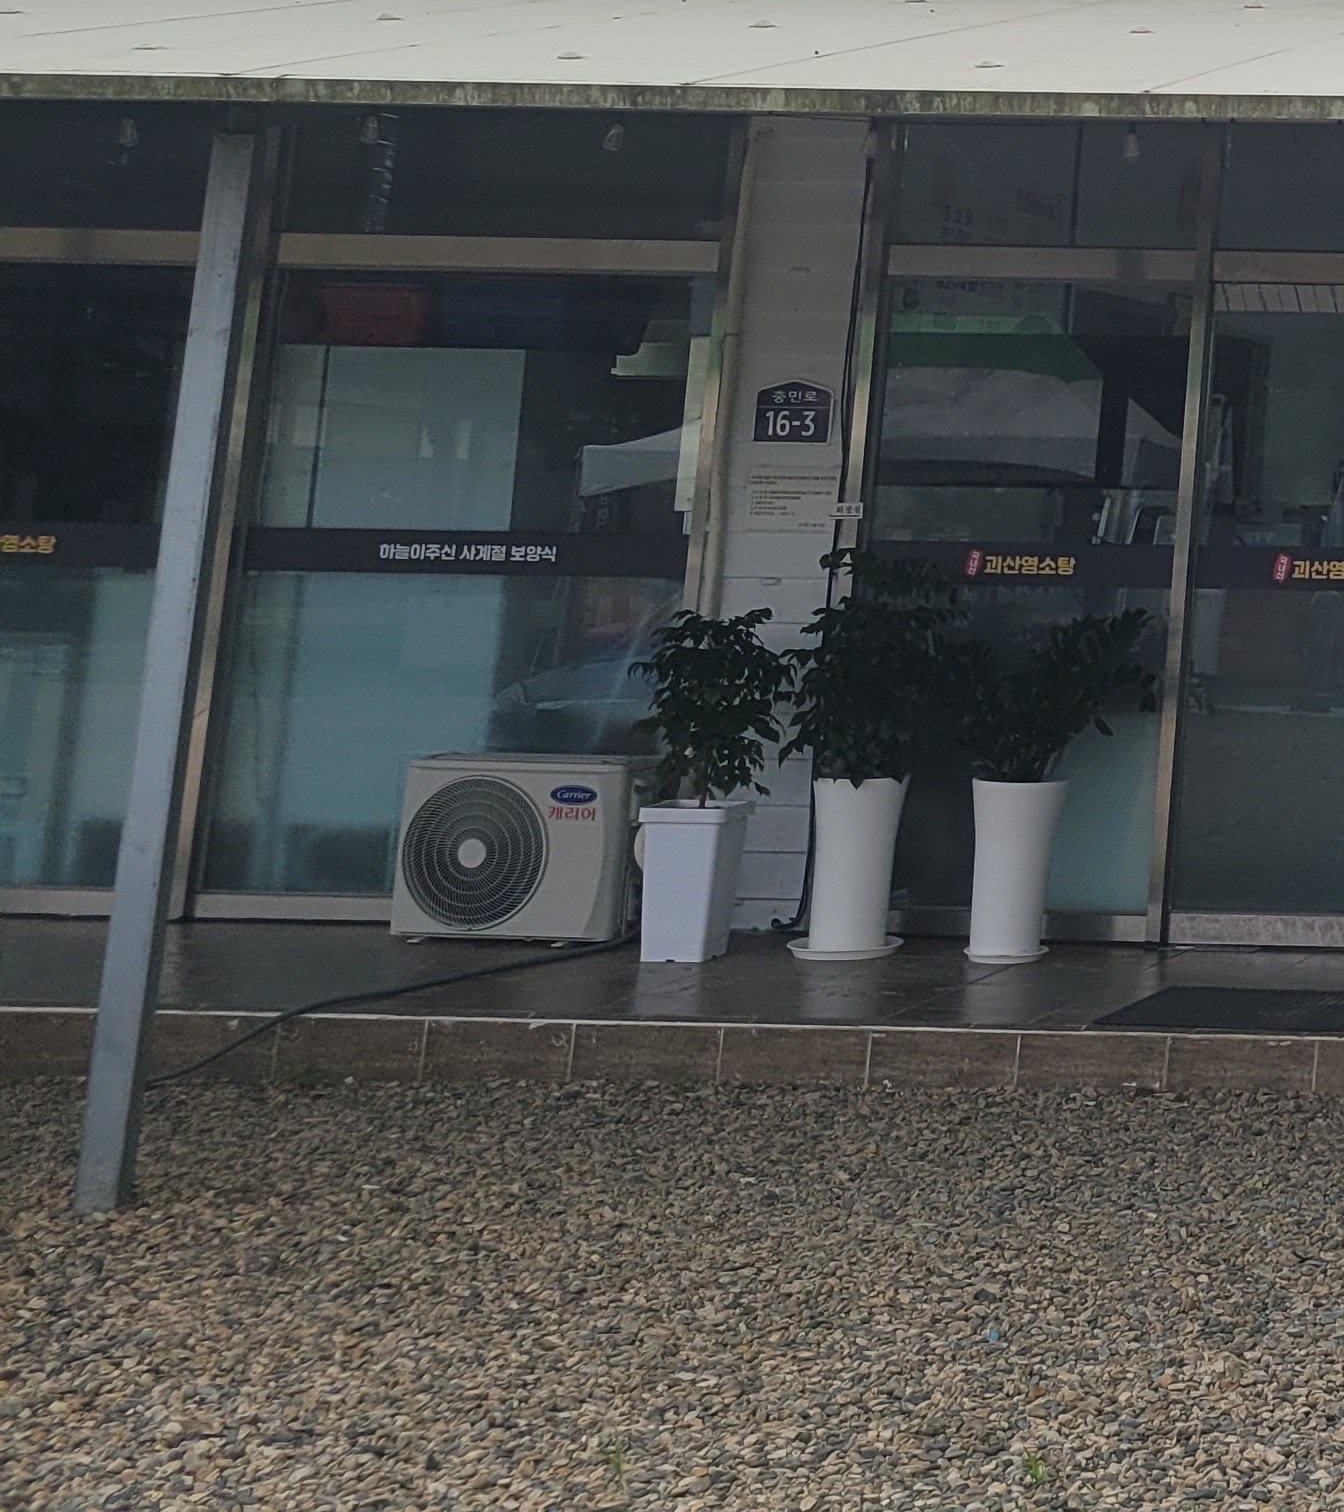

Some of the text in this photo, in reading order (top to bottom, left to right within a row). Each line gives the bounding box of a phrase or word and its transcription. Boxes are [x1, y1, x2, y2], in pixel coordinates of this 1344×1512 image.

[765, 410, 816, 437] 16-3
[378, 542, 557, 563] 하늘이주신 사계절 보양식
[984, 555, 1077, 576] 괴산염소탕
[556, 789, 593, 800] Carrier
[548, 806, 596, 821] 캐리어
